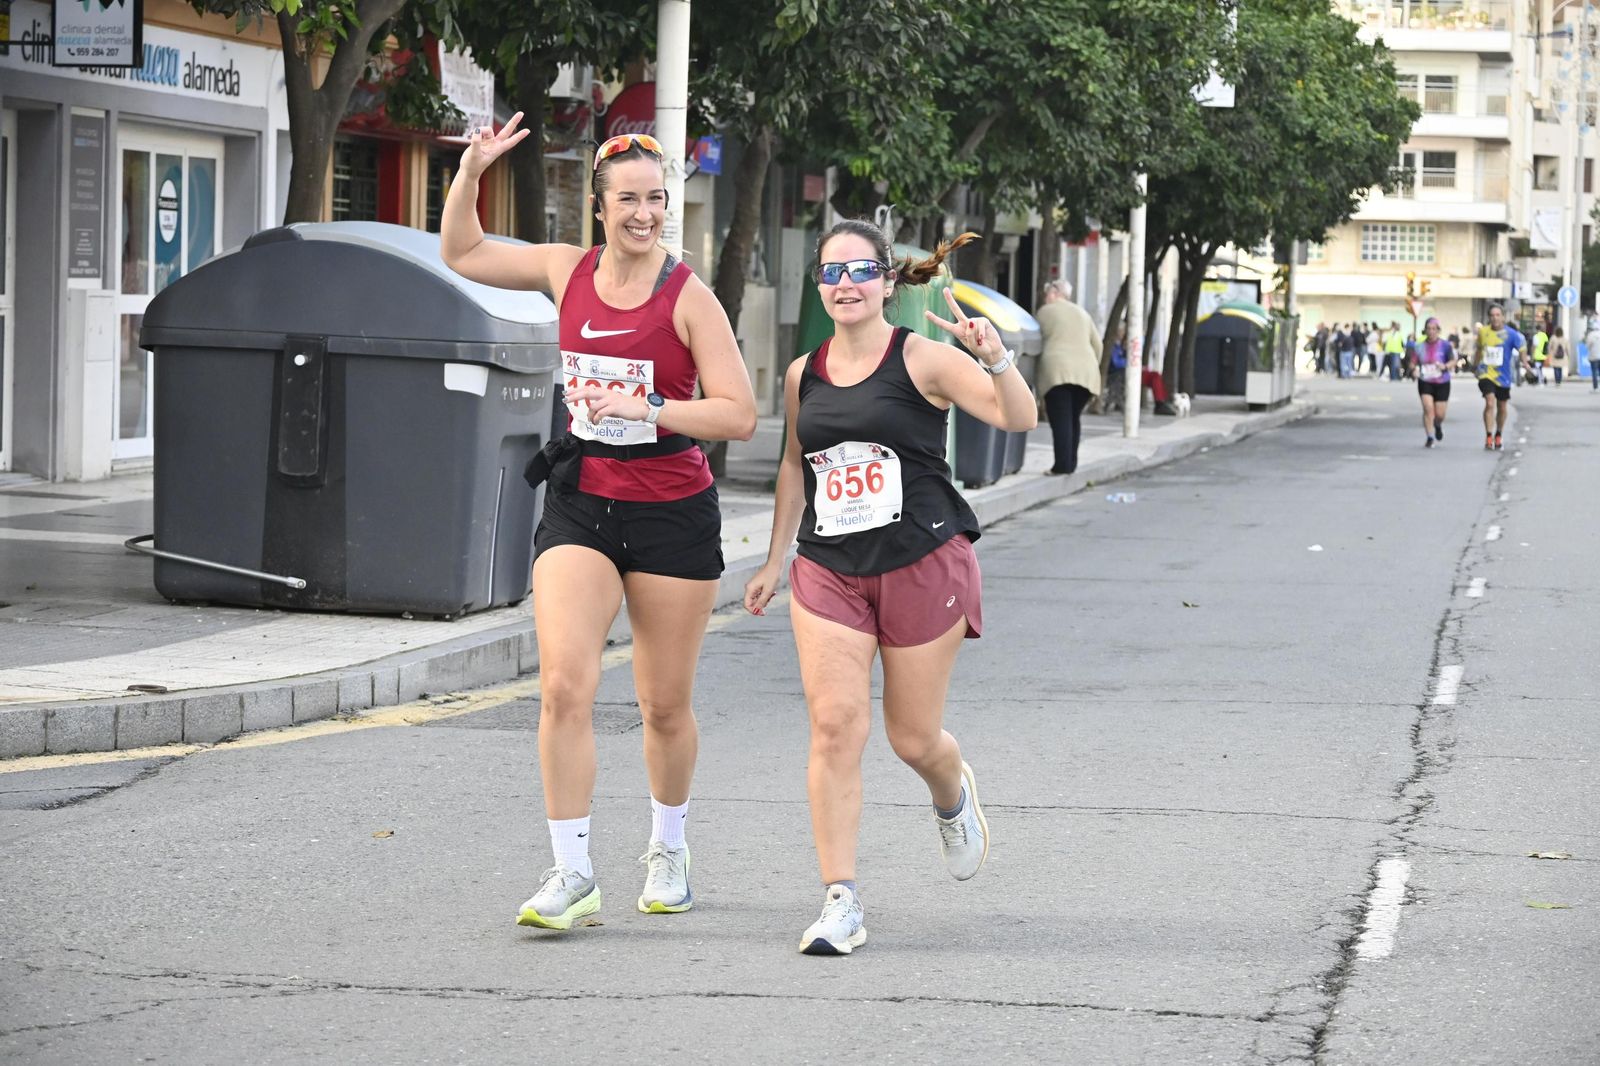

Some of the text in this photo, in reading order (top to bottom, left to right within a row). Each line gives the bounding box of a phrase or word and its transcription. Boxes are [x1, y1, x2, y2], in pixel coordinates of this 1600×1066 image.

[94, 24, 125, 34] dental
[94, 36, 132, 45] alameda
[76, 47, 119, 56] 959 284 207
[183, 51, 240, 97] alameda
[567, 355, 580, 370] 2K
[627, 363, 646, 377] 2K
[586, 424, 624, 437] Huelva
[826, 461, 884, 502] 656
[835, 512, 873, 527] Huelva
